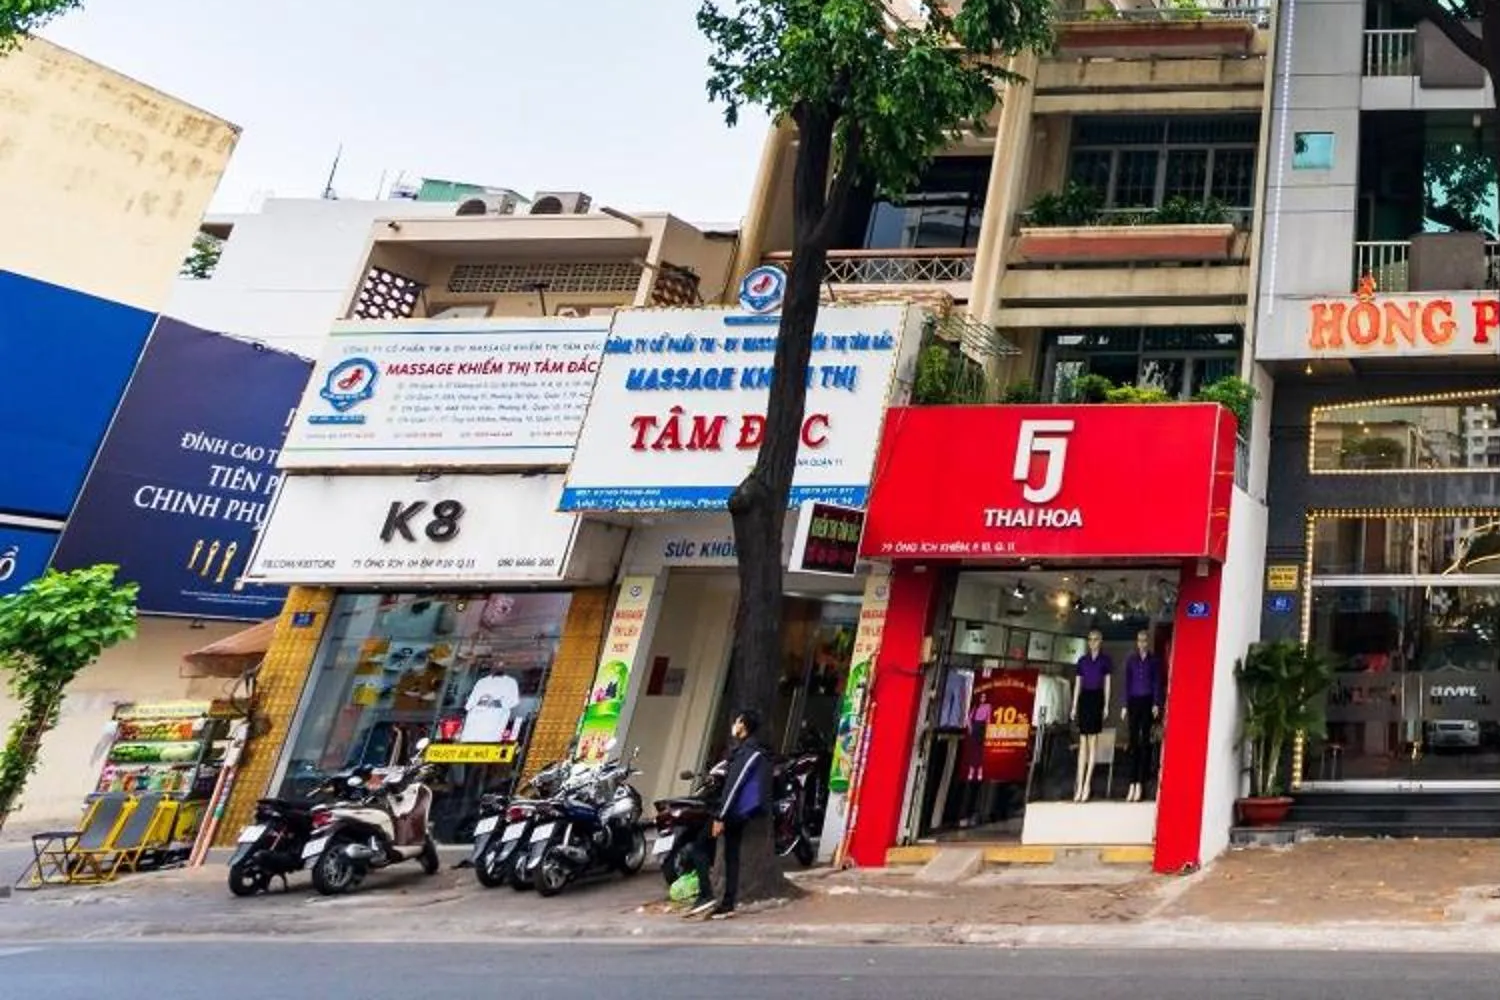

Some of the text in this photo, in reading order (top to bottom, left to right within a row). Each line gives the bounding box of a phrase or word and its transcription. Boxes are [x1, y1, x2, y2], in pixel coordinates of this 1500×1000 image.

[1309, 275, 1457, 349] HỒNG
[385, 362, 454, 375] MASSAGE
[457, 356, 503, 375] KHIẾM
[508, 361, 531, 377] THỊ
[567, 354, 598, 373] ĐẮC
[625, 367, 737, 391] MASSAGE
[820, 366, 858, 392] THỊ
[631, 406, 831, 451] TÂM ĐC
[230, 443, 264, 462] CAO
[208, 464, 262, 493] TIÊN
[134, 485, 268, 531] CHINH PHỤ
[380, 499, 463, 543] K8
[985, 509, 1083, 527] THAI HOA
[664, 539, 695, 558] SÚC
[895, 541, 918, 552] ÔNG
